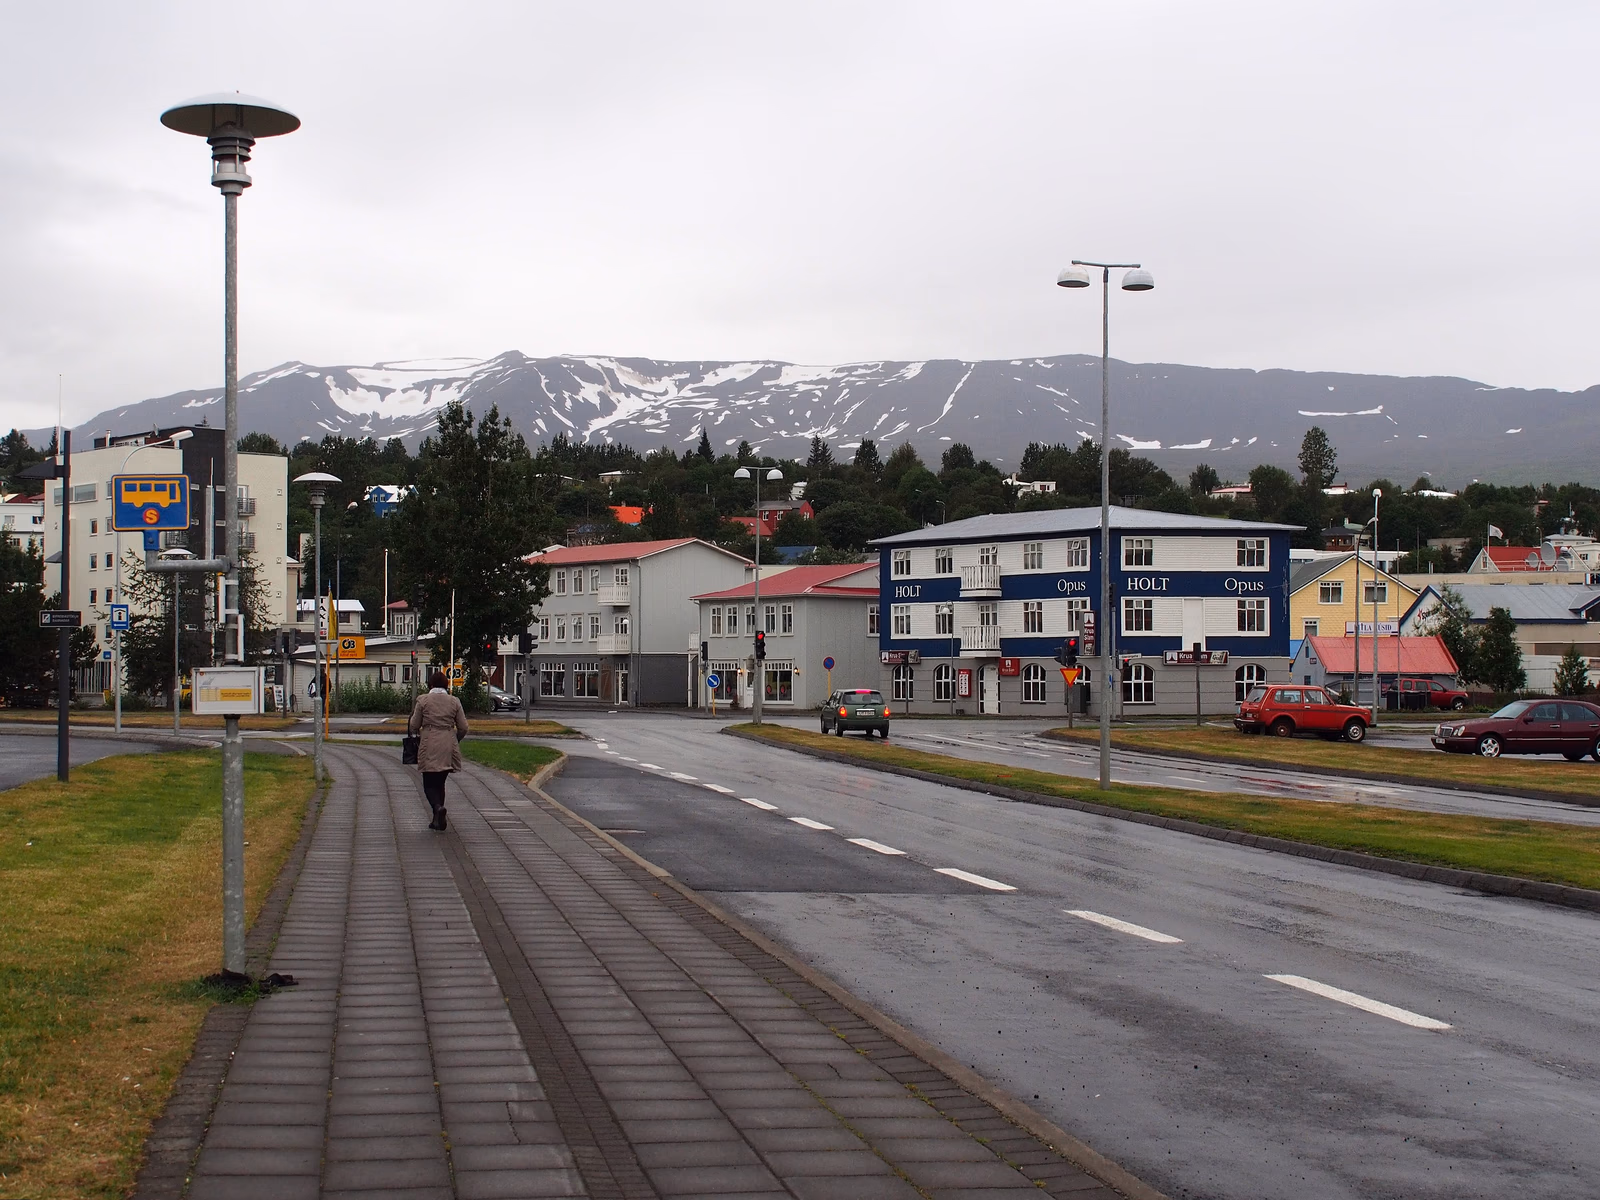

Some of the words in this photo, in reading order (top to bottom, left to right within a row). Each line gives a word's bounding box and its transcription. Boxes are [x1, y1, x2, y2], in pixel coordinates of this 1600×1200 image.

[146, 509, 158, 524] S
[895, 585, 923, 598] HOLT
[1057, 578, 1086, 596] Opus
[1127, 577, 1170, 591] HOLT
[1224, 577, 1264, 595] Opus
[319, 597, 327, 627] TAXI
